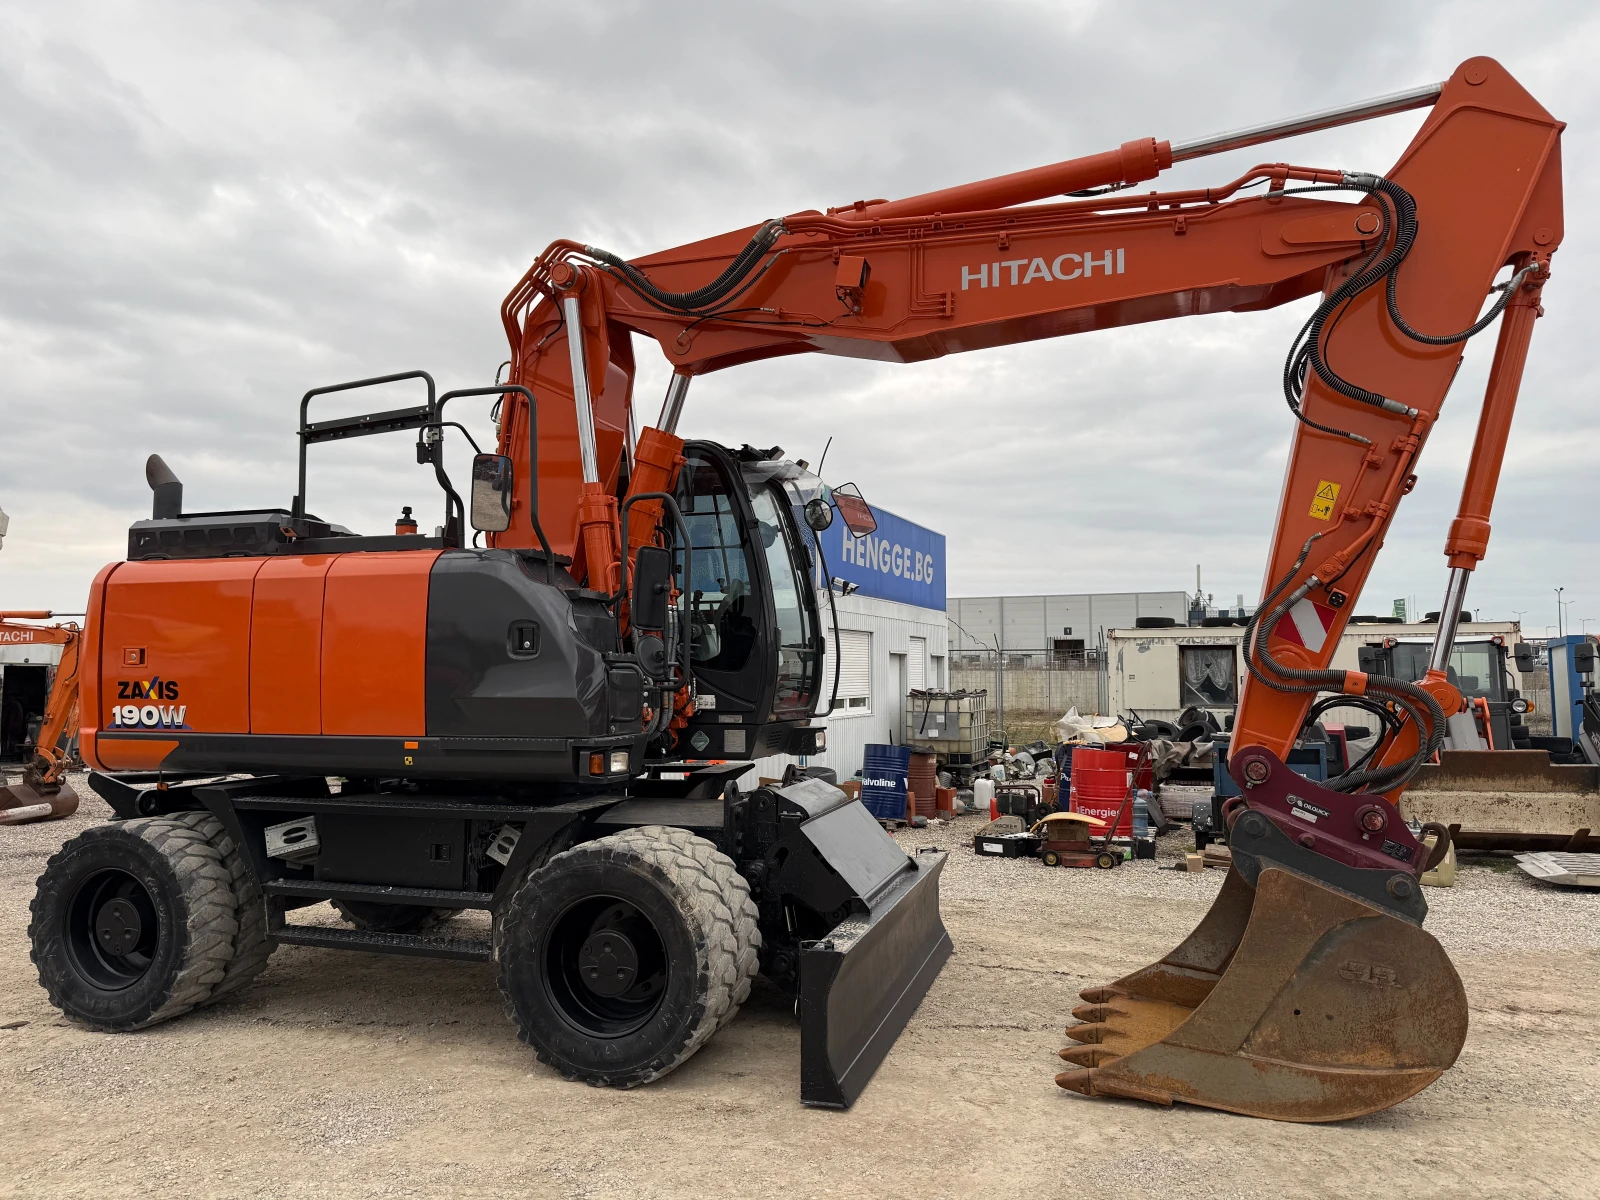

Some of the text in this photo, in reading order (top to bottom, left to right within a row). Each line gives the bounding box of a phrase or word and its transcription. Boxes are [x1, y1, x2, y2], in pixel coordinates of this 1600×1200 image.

[961, 248, 1125, 291] HITACHI
[841, 525, 934, 585] HENGGE.BG
[0, 631, 34, 642] TACHI
[117, 676, 179, 700] ZAXIS
[112, 705, 187, 729] 190W
